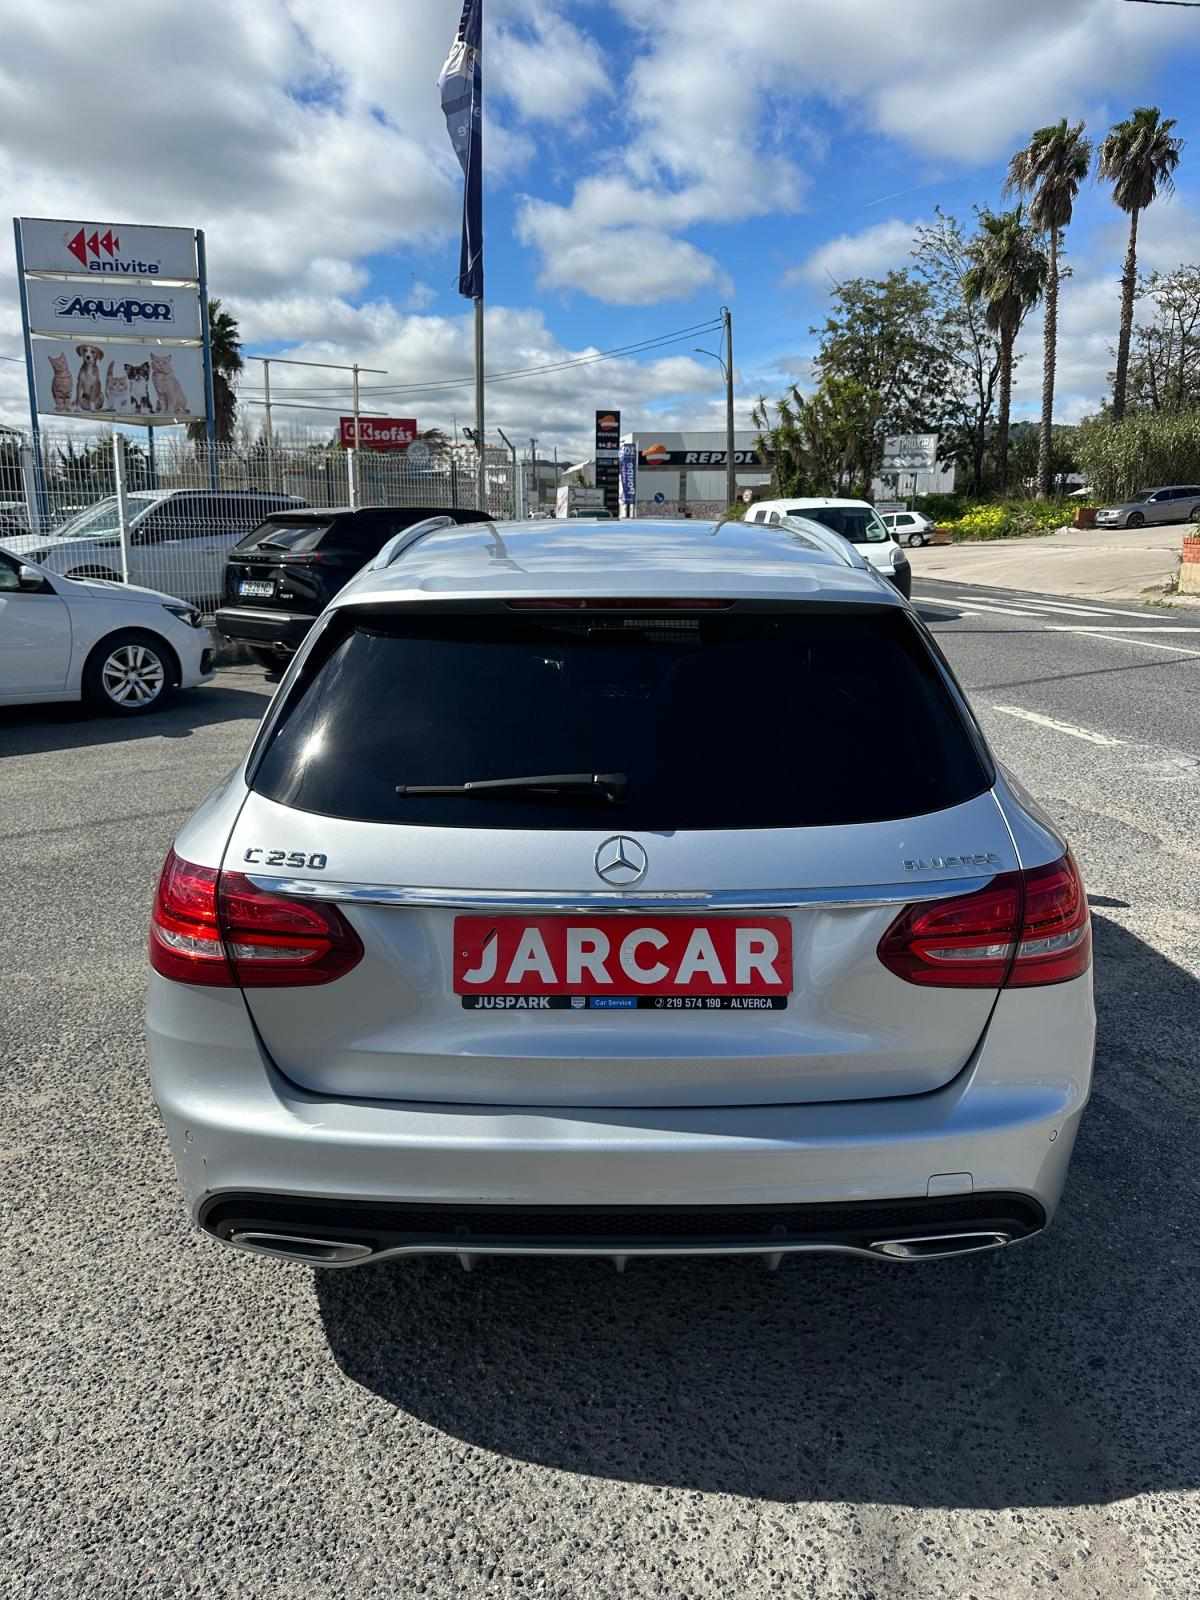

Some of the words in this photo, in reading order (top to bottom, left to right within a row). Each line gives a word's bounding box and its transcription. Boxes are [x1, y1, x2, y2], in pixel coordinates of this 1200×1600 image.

[89, 258, 160, 274] anivite
[243, 847, 263, 864] C
[265, 849, 328, 870] 250
[462, 927, 783, 985] JARCAR
[474, 996, 551, 1009] JUSPARK
[594, 999, 607, 1007] Car
[608, 999, 633, 1007] Service
[666, 998, 683, 1009] 219
[685, 998, 702, 1009] 574
[731, 998, 773, 1009] ALVERCA
